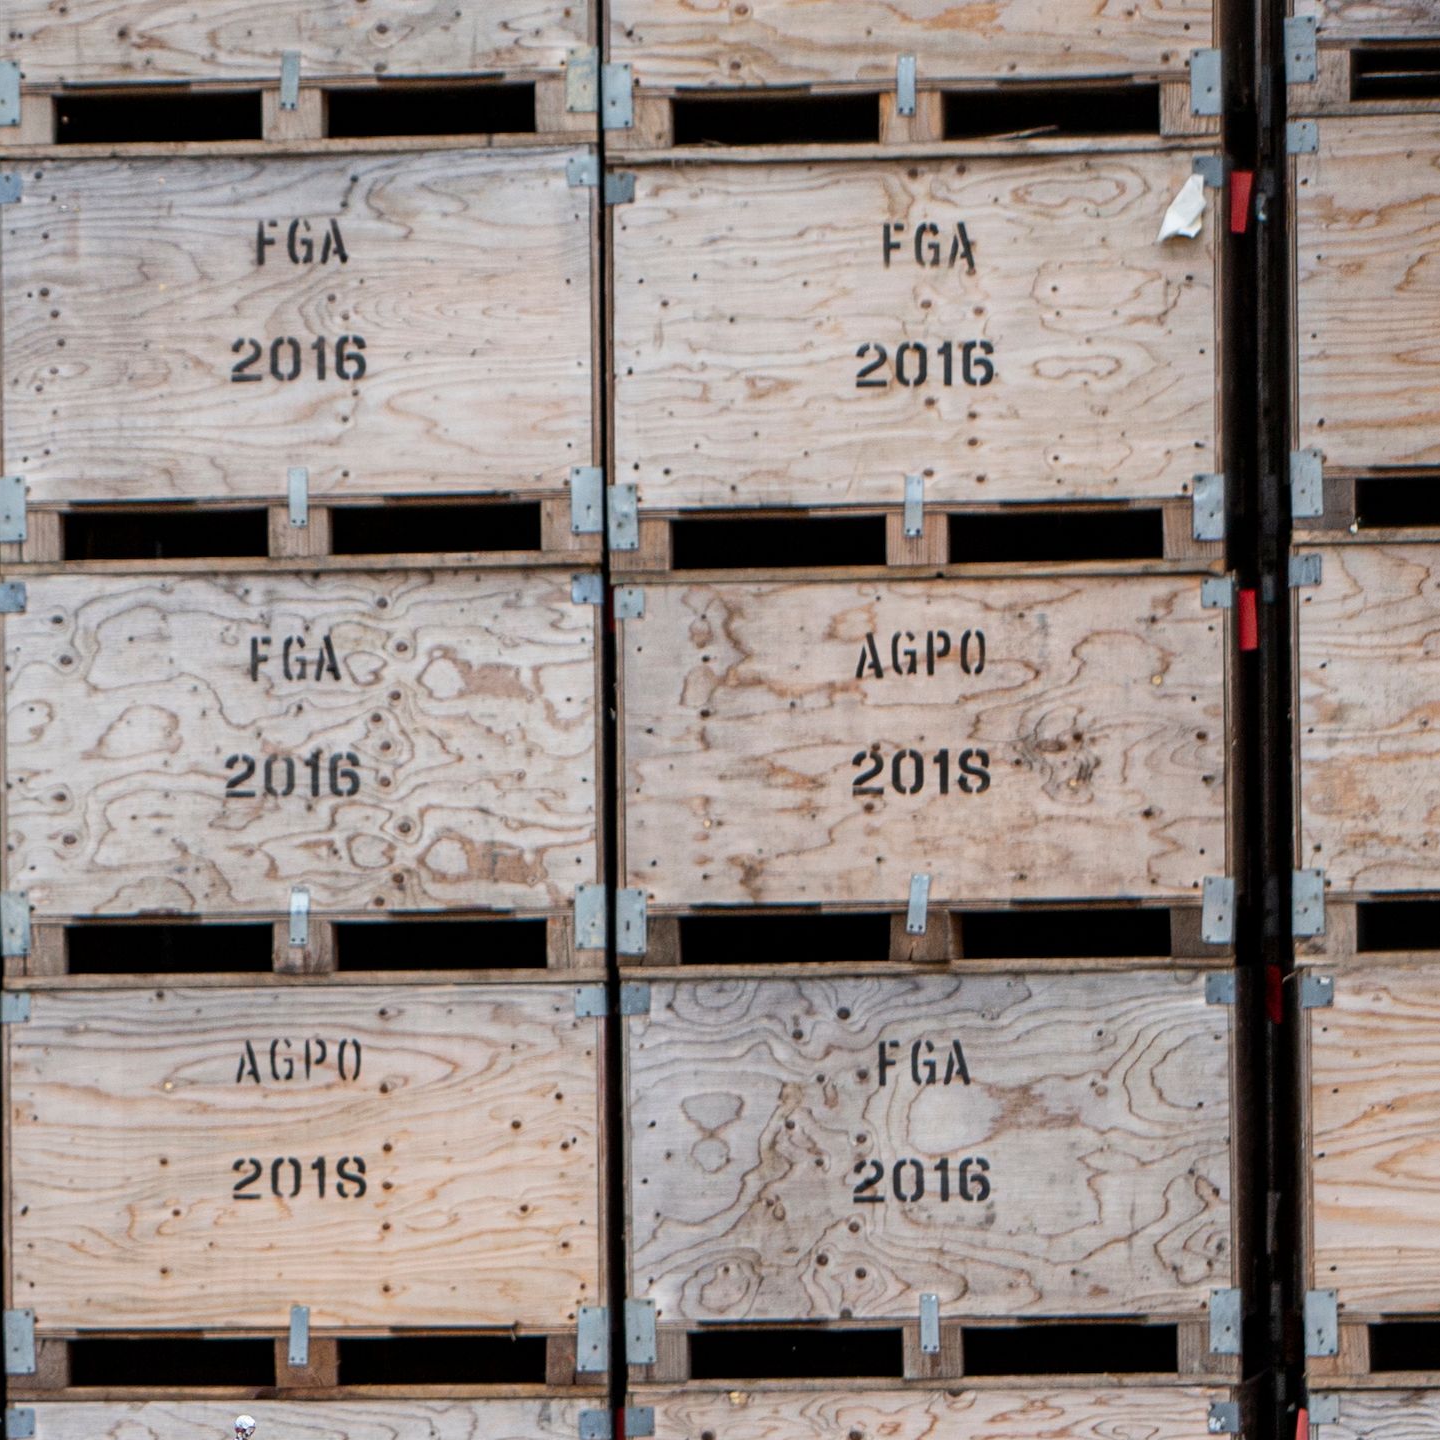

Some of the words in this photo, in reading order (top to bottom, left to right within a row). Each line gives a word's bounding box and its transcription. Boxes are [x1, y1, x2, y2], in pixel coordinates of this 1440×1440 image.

[256, 219, 348, 266] FGA
[882, 222, 977, 269] FGA
[230, 336, 367, 382] 2016
[856, 341, 995, 388] 2016
[249, 635, 344, 682] FGA
[856, 629, 987, 678] AGPO
[225, 753, 361, 799] 2016
[851, 748, 991, 795] 2018
[236, 1038, 363, 1083] AGPO
[877, 1040, 971, 1086] FGA
[232, 1156, 367, 1201] 2018
[853, 1158, 991, 1203] 2016
